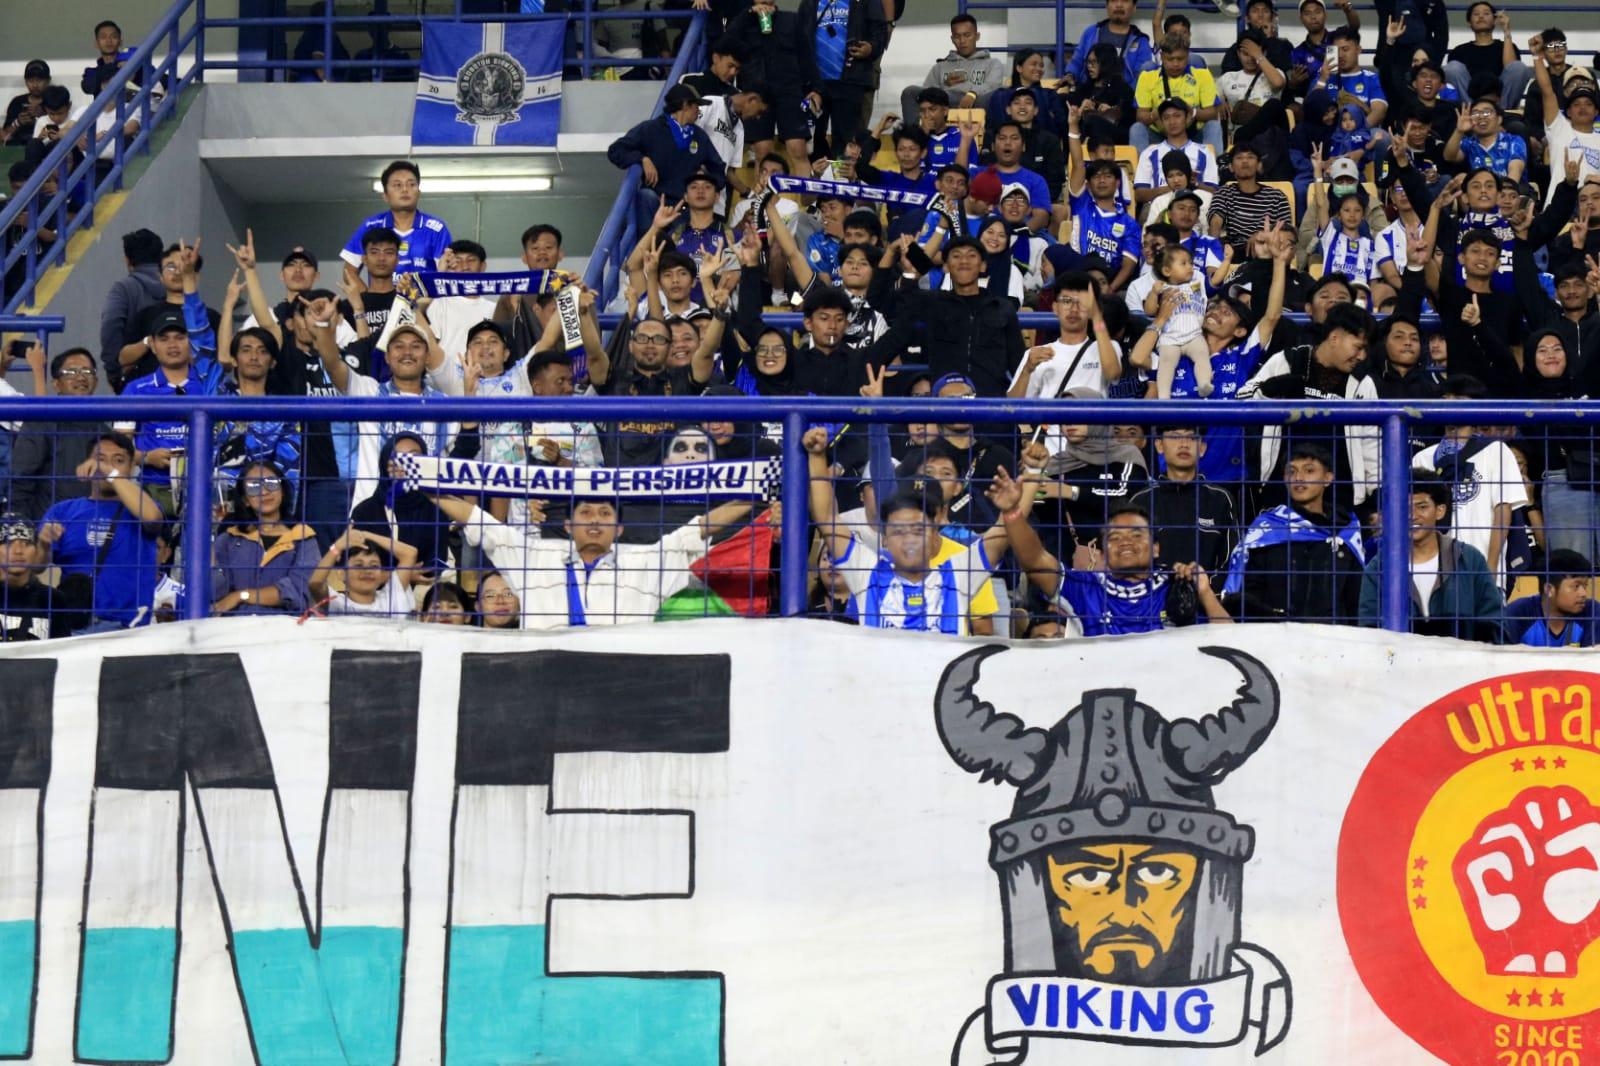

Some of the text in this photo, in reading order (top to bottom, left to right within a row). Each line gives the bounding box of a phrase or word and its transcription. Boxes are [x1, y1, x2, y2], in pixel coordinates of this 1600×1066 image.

[428, 85, 439, 94] 20
[775, 176, 929, 206] PERSIB
[437, 461, 748, 492] JAYALAH PERSIBKU
[1446, 682, 1600, 754] ultra
[1006, 983, 1215, 1034] VIKING
[1494, 1023, 1583, 1049] SINCE
